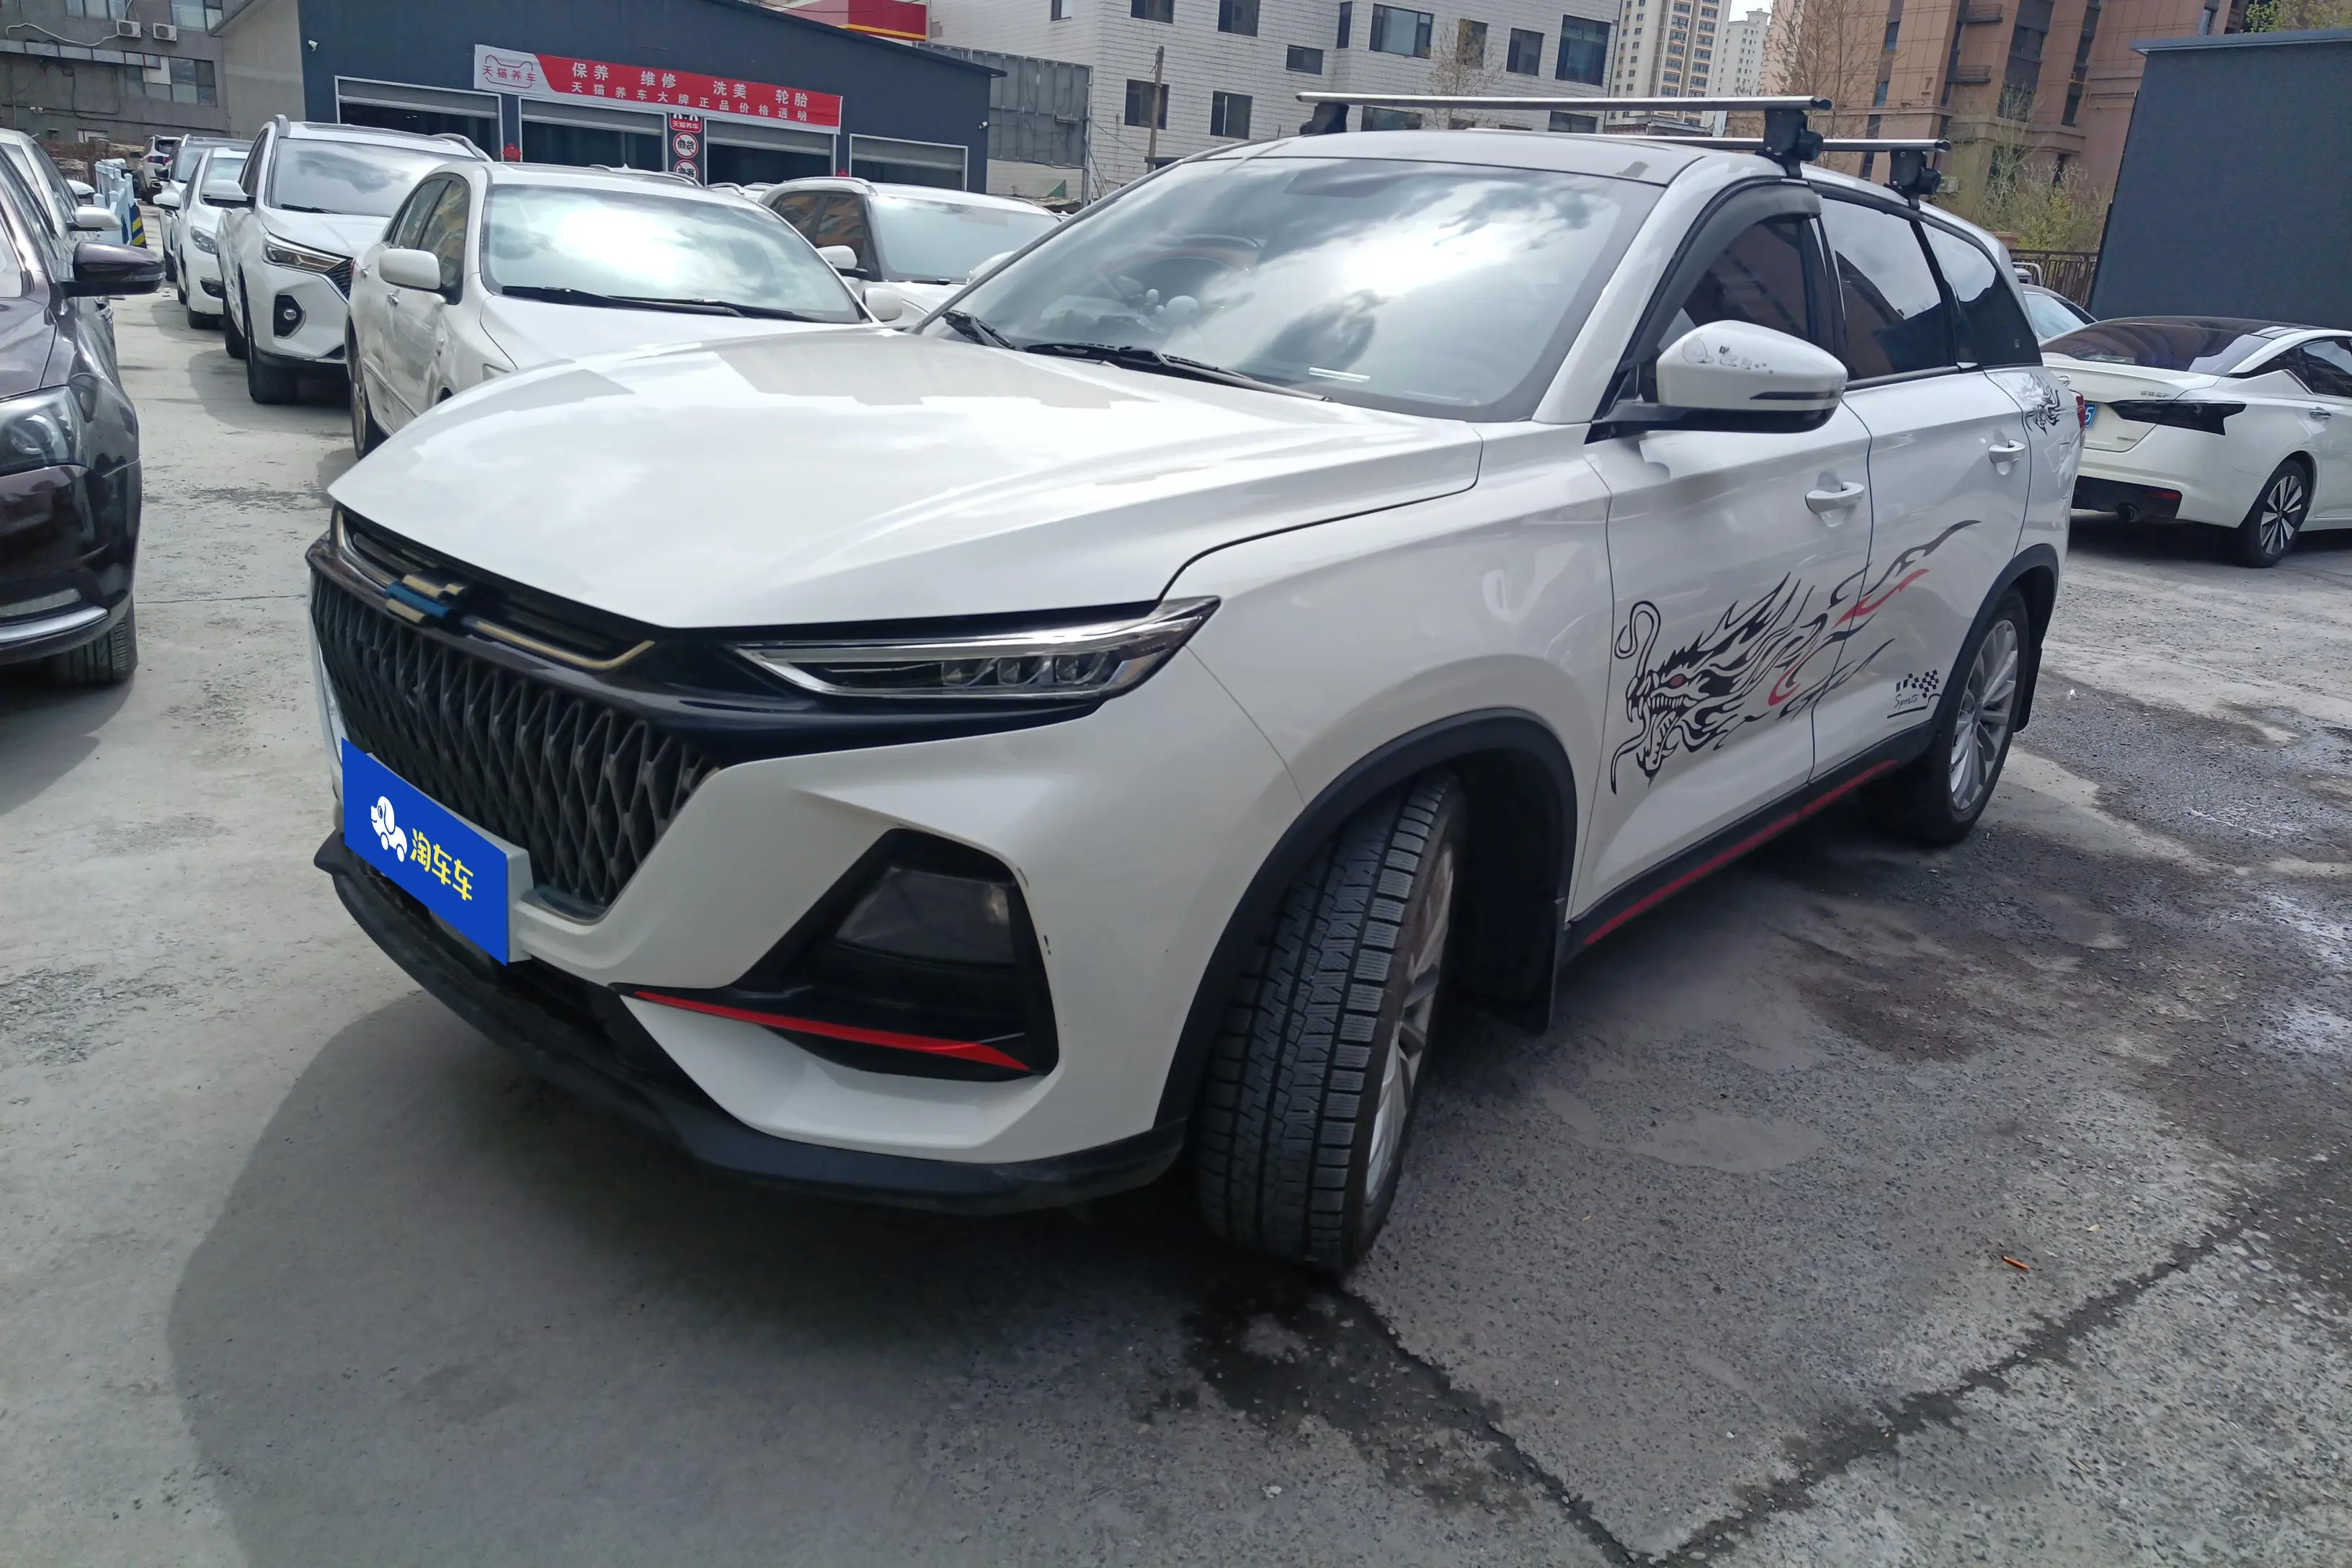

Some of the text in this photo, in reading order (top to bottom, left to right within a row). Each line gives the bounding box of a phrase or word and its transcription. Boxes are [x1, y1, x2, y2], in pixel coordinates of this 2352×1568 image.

[482, 65, 537, 82] 天猫养车
[571, 62, 808, 107] 保养 维修 洗美 轮胎
[571, 81, 807, 122] 天猫养车大牌正品价格透明
[1894, 694, 1918, 710] Sports
